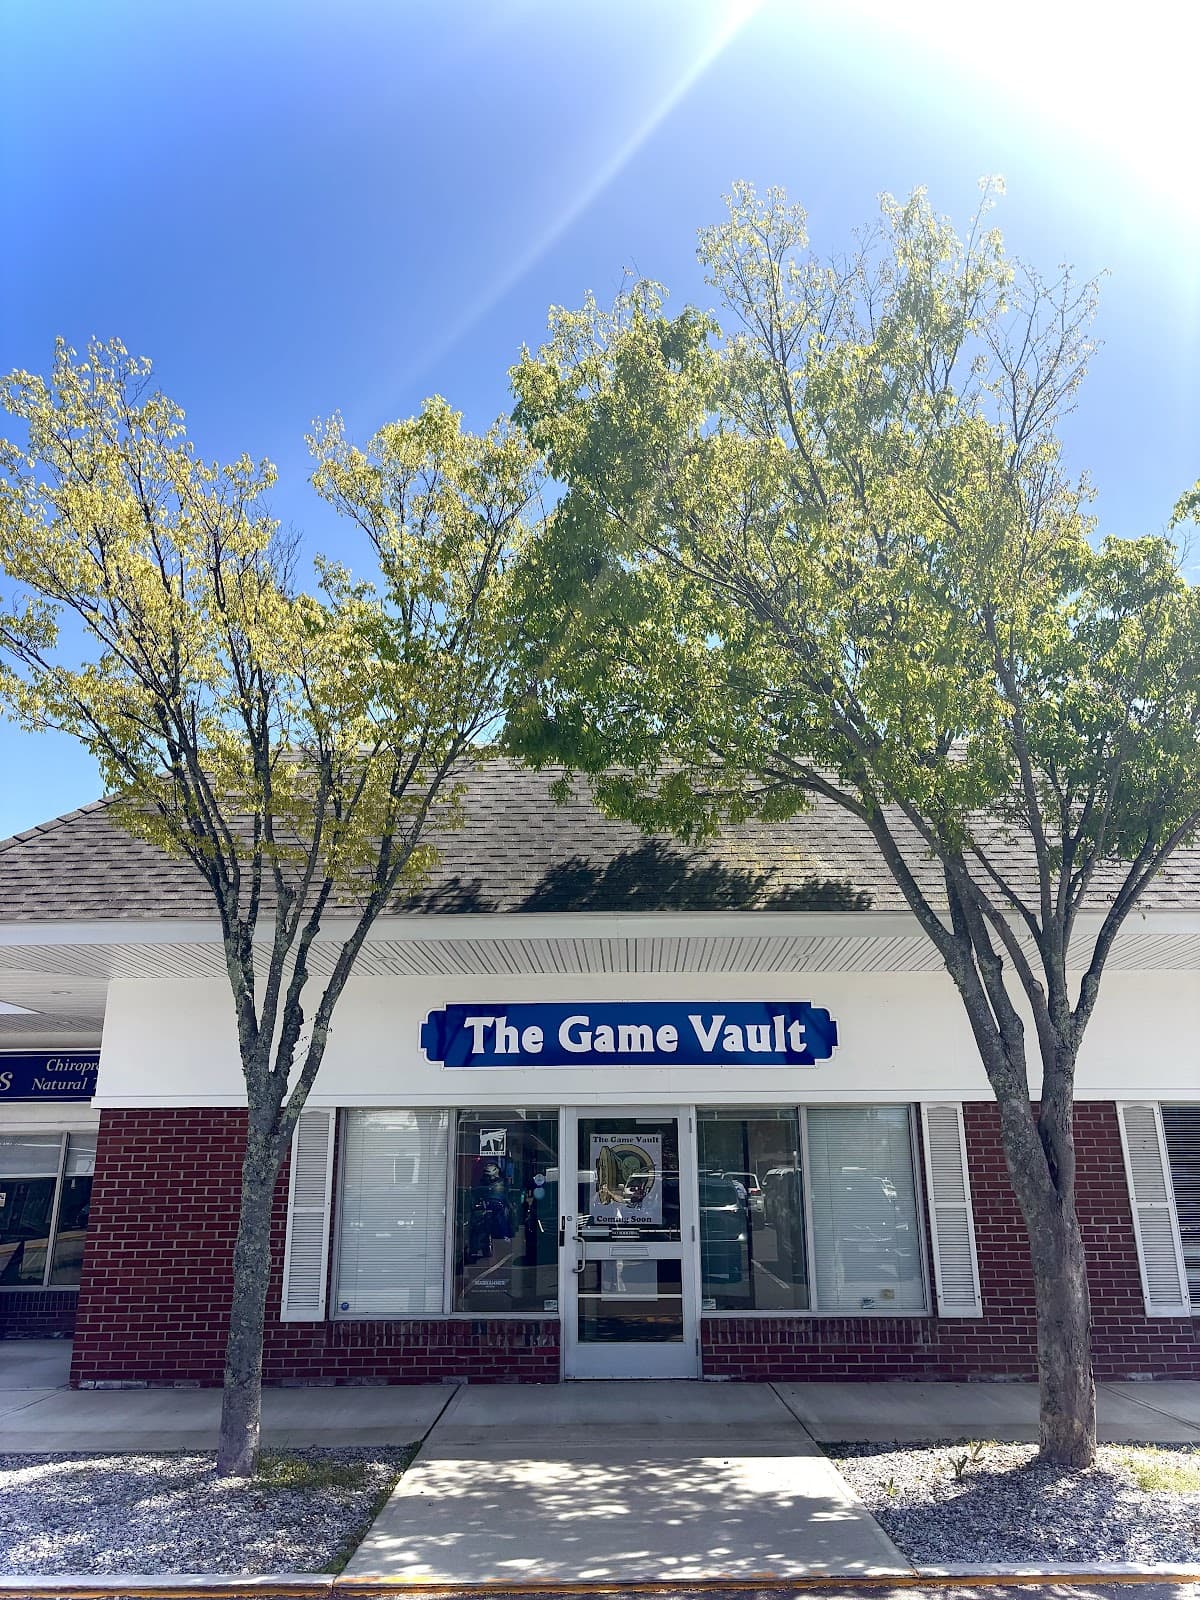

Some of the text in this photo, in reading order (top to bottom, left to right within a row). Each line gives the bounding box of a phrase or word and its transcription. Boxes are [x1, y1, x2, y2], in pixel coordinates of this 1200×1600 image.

[463, 1014, 808, 1054] The Game Vault
[31, 1077, 88, 1091] Natural
[630, 1215, 652, 1223] Soon
